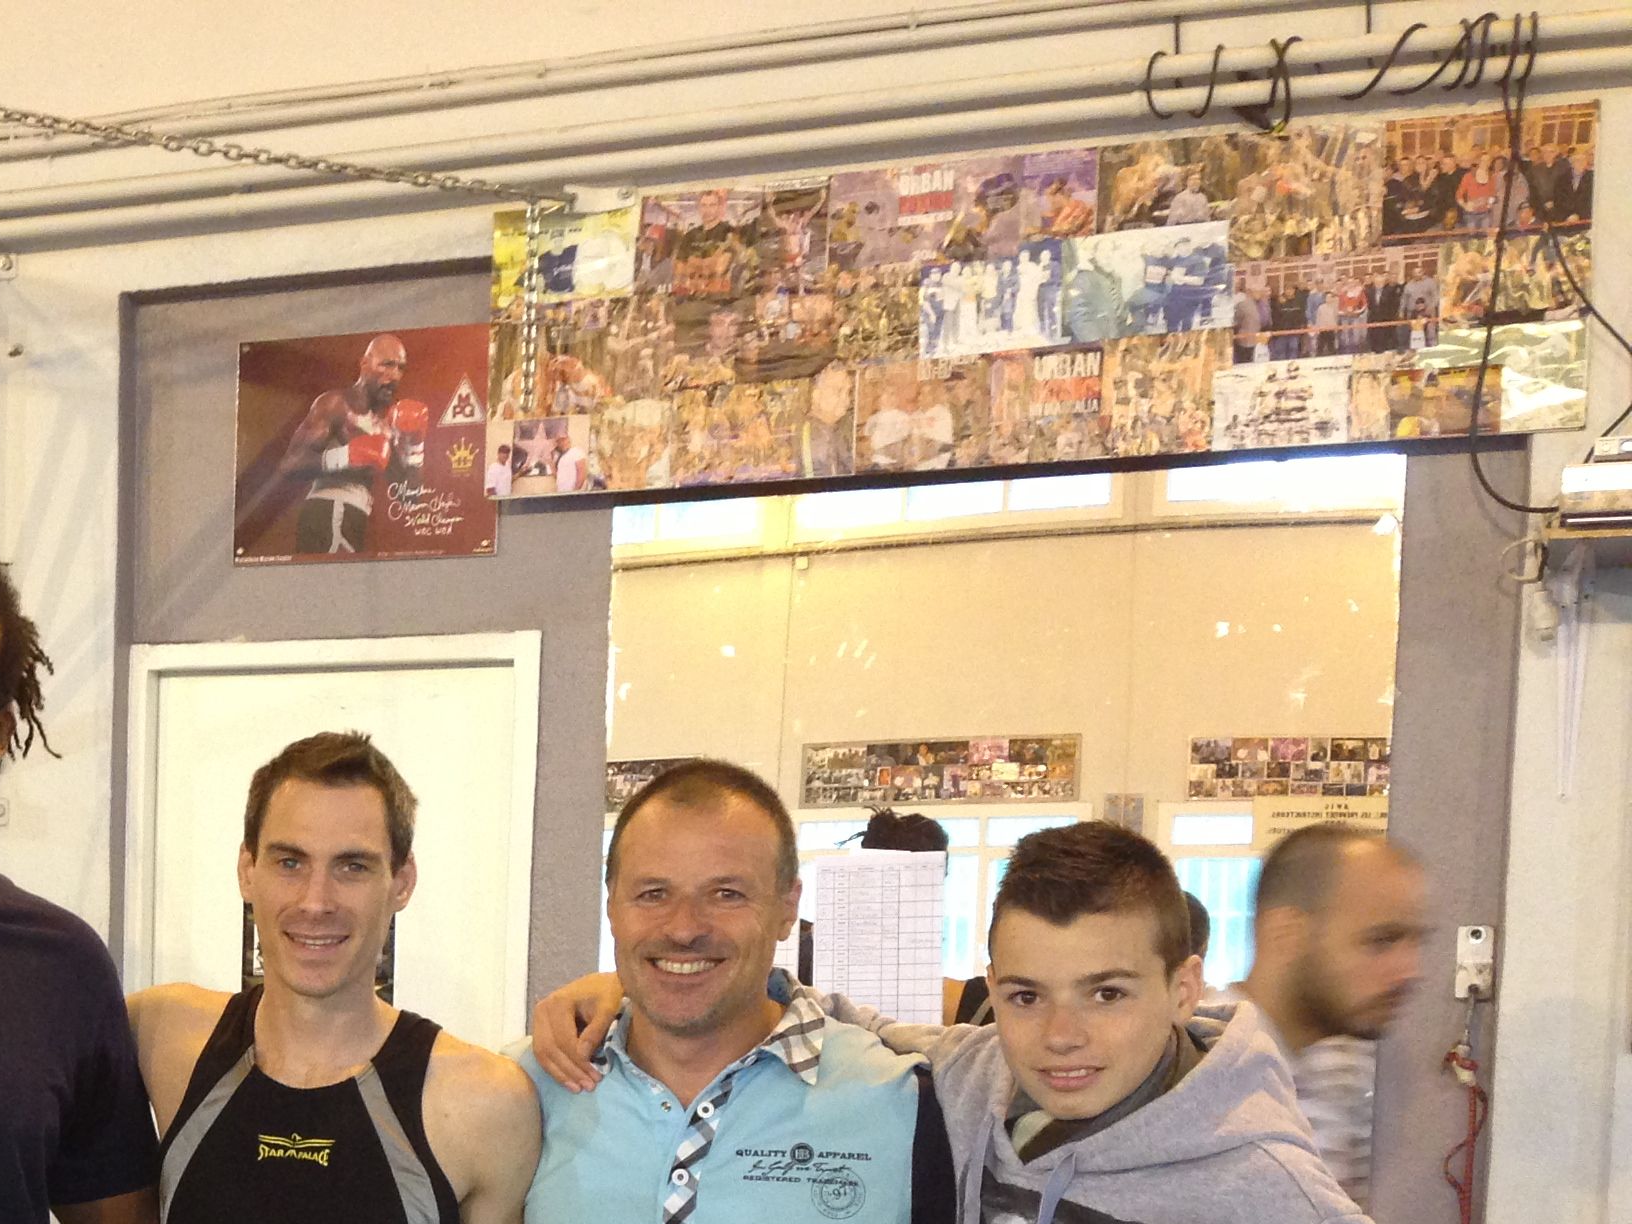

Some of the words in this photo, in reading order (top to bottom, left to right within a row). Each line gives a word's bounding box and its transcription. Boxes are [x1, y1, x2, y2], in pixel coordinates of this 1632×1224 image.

[1034, 351, 1102, 381] URBAN
[735, 1149, 787, 1158] QUALITY
[817, 1151, 872, 1161] APPAREL
[743, 1175, 801, 1183] REGISTERED
